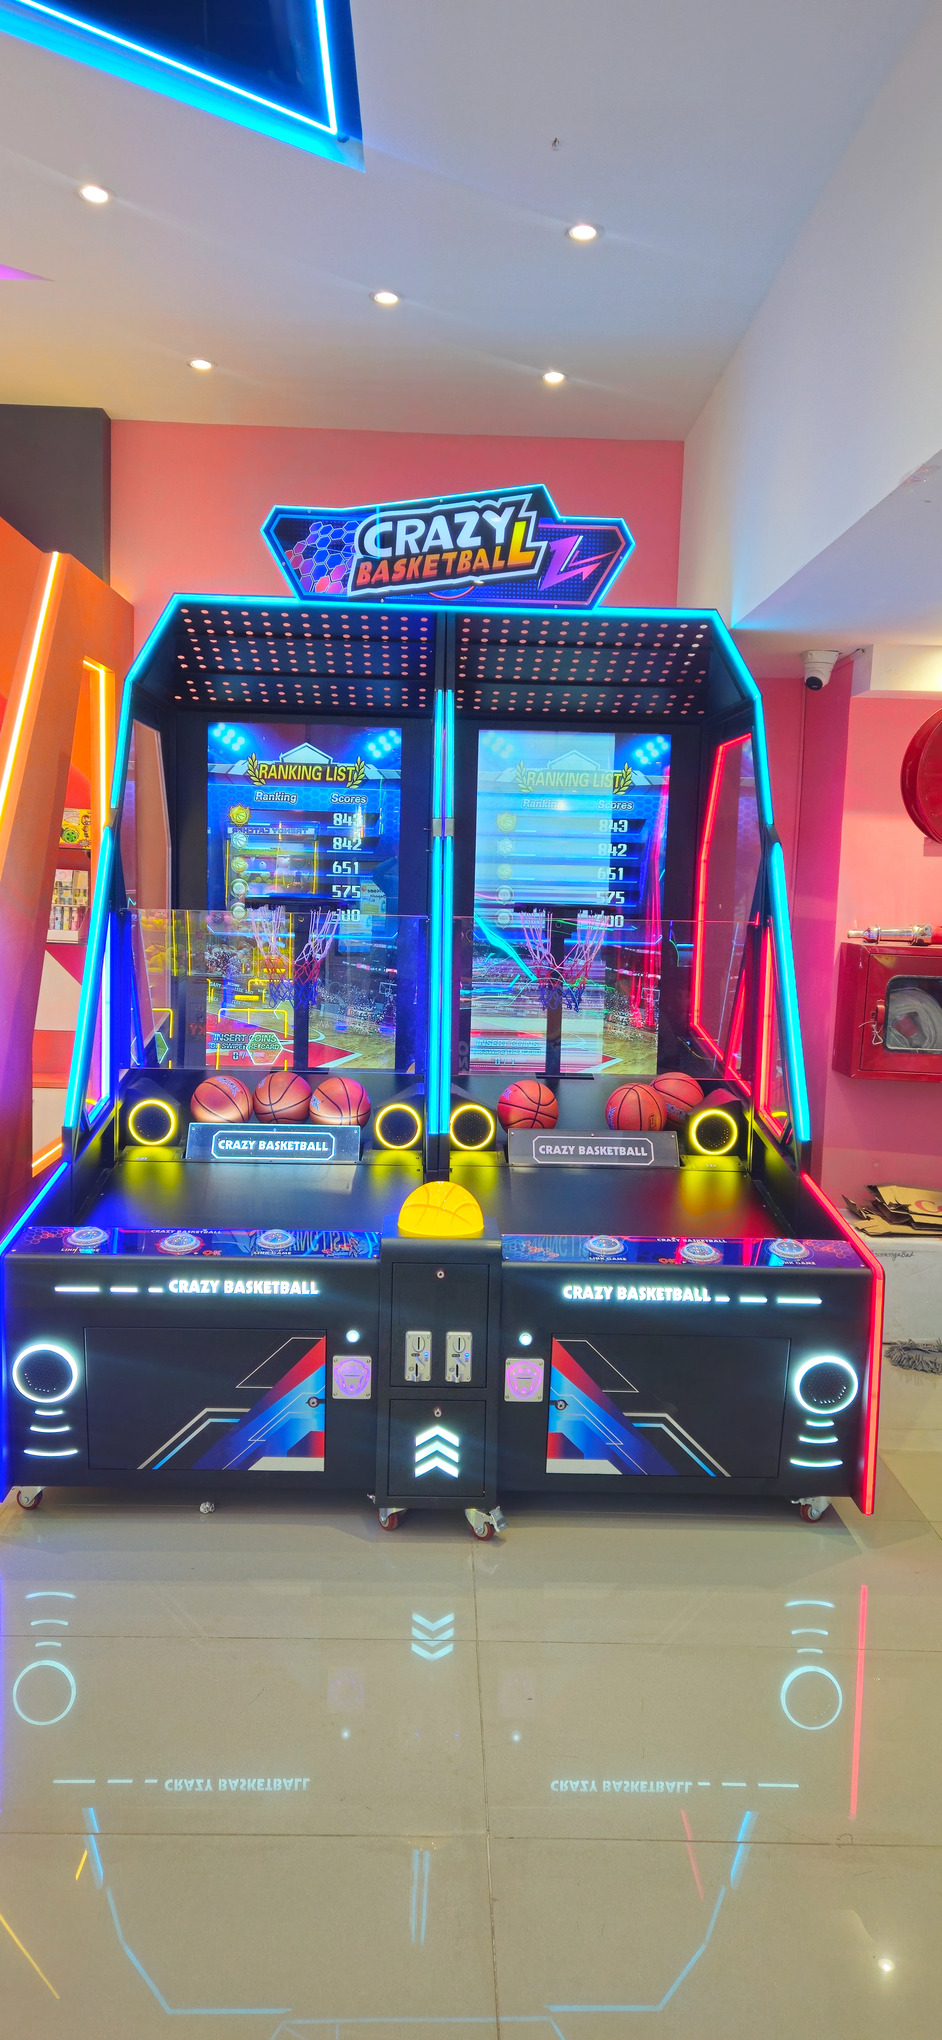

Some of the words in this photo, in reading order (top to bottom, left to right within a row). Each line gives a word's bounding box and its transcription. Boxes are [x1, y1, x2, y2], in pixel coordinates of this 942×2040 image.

[363, 506, 515, 558] CRAZY
[355, 521, 536, 586] BASKETBALL
[258, 764, 322, 781] RANKING
[326, 766, 355, 782] LIST
[526, 771, 589, 788] RANKING
[593, 773, 622, 788] LIST
[255, 791, 298, 804] Ranking
[330, 792, 367, 804] Scores
[597, 800, 633, 811] Scores
[333, 813, 362, 827] 843
[599, 819, 628, 833] 843
[332, 837, 362, 851] 842
[598, 843, 628, 857] 842
[332, 861, 359, 875] 651
[597, 867, 624, 881] 651
[332, 885, 361, 898] 575
[596, 891, 625, 904] 575
[213, 1034, 247, 1042] INSERT
[248, 1034, 277, 1043] COINS
[218, 1139, 256, 1150] CRAZY
[258, 1140, 329, 1151] BASKETBALL
[538, 1144, 576, 1155] CRAZY
[578, 1145, 648, 1157] BASKETBALL
[168, 1279, 220, 1294] CRAZY
[223, 1280, 320, 1295] BASKETBALL
[562, 1285, 613, 1300] CRAZY
[617, 1286, 711, 1302] BASKETBALL
